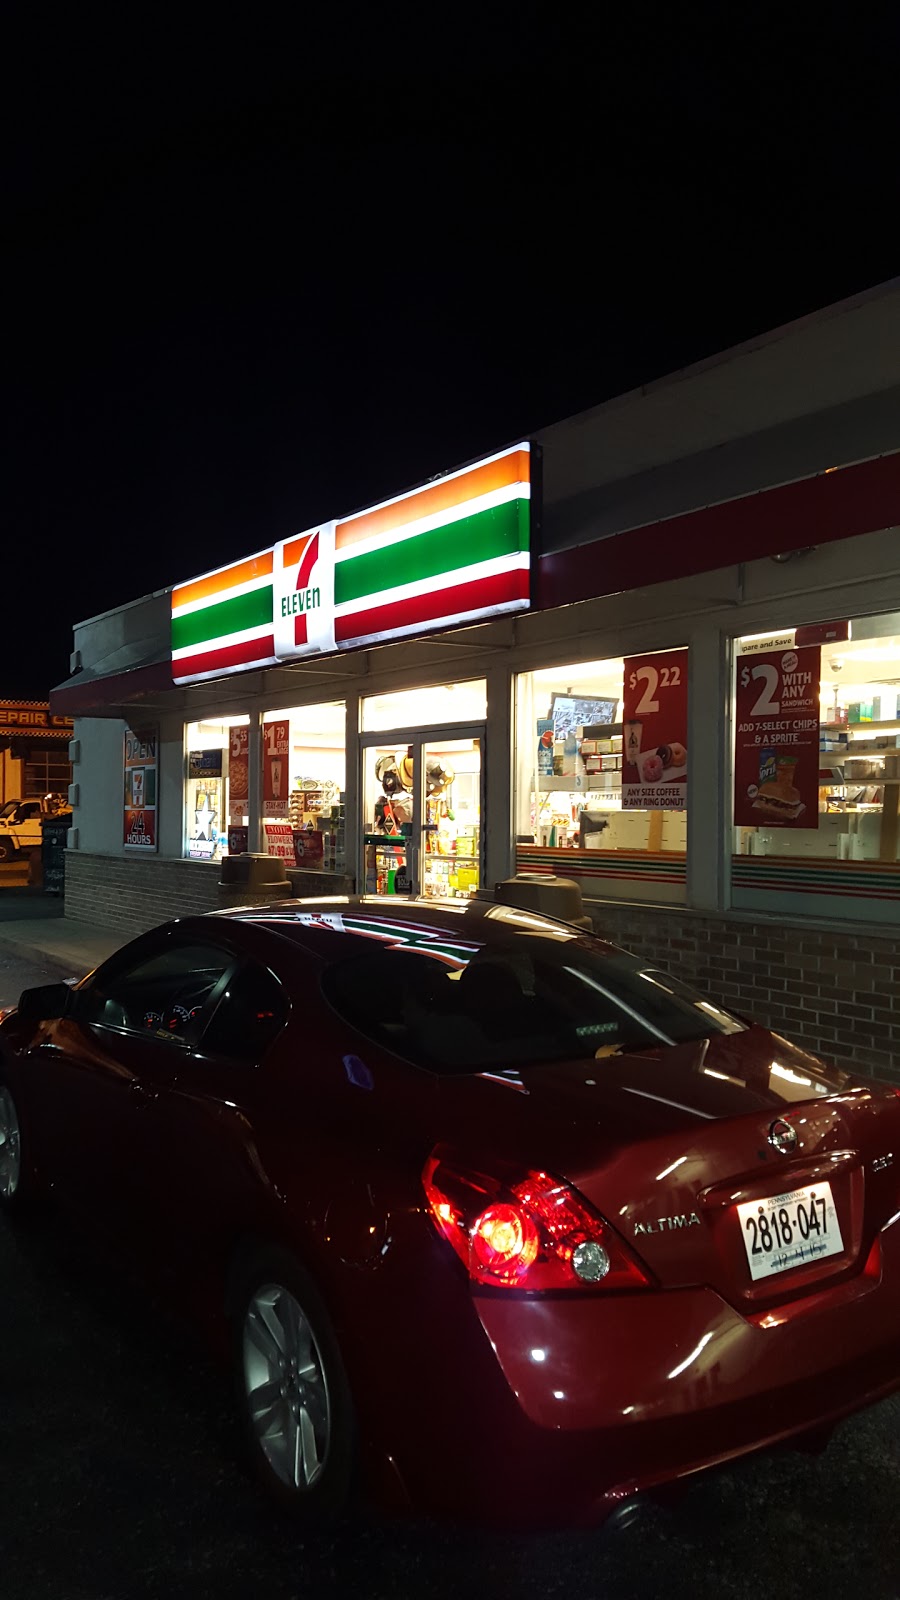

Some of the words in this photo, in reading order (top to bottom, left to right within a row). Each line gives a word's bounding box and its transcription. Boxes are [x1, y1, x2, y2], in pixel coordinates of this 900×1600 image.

[282, 531, 320, 646] 7
[759, 640, 773, 649] and
[774, 638, 792, 646] Save
[782, 671, 812, 686] WITH
[781, 685, 806, 698] ANY
[781, 698, 813, 708] SANDWICH
[738, 723, 755, 732] ADD
[755, 720, 790, 732] 7-SELECT
[792, 719, 818, 729] CHIPS
[754, 734, 762, 744] &
[763, 734, 769, 743] A
[770, 732, 799, 743] SPRITE
[127, 736, 156, 762] OPEN
[627, 788, 641, 796] ANY
[641, 788, 655, 796] SIZE
[656, 787, 681, 796] COFFEE
[623, 798, 629, 806] &
[629, 798, 643, 806] ANY
[643, 798, 659, 806] RING
[660, 797, 685, 806] DONUT
[131, 811, 146, 834] 24
[126, 833, 152, 845] HOURS
[267, 835, 293, 845] FLOWERS
[768, 1191, 805, 1205] PENNSYLVANIA
[634, 1212, 701, 1237] ALTIMA
